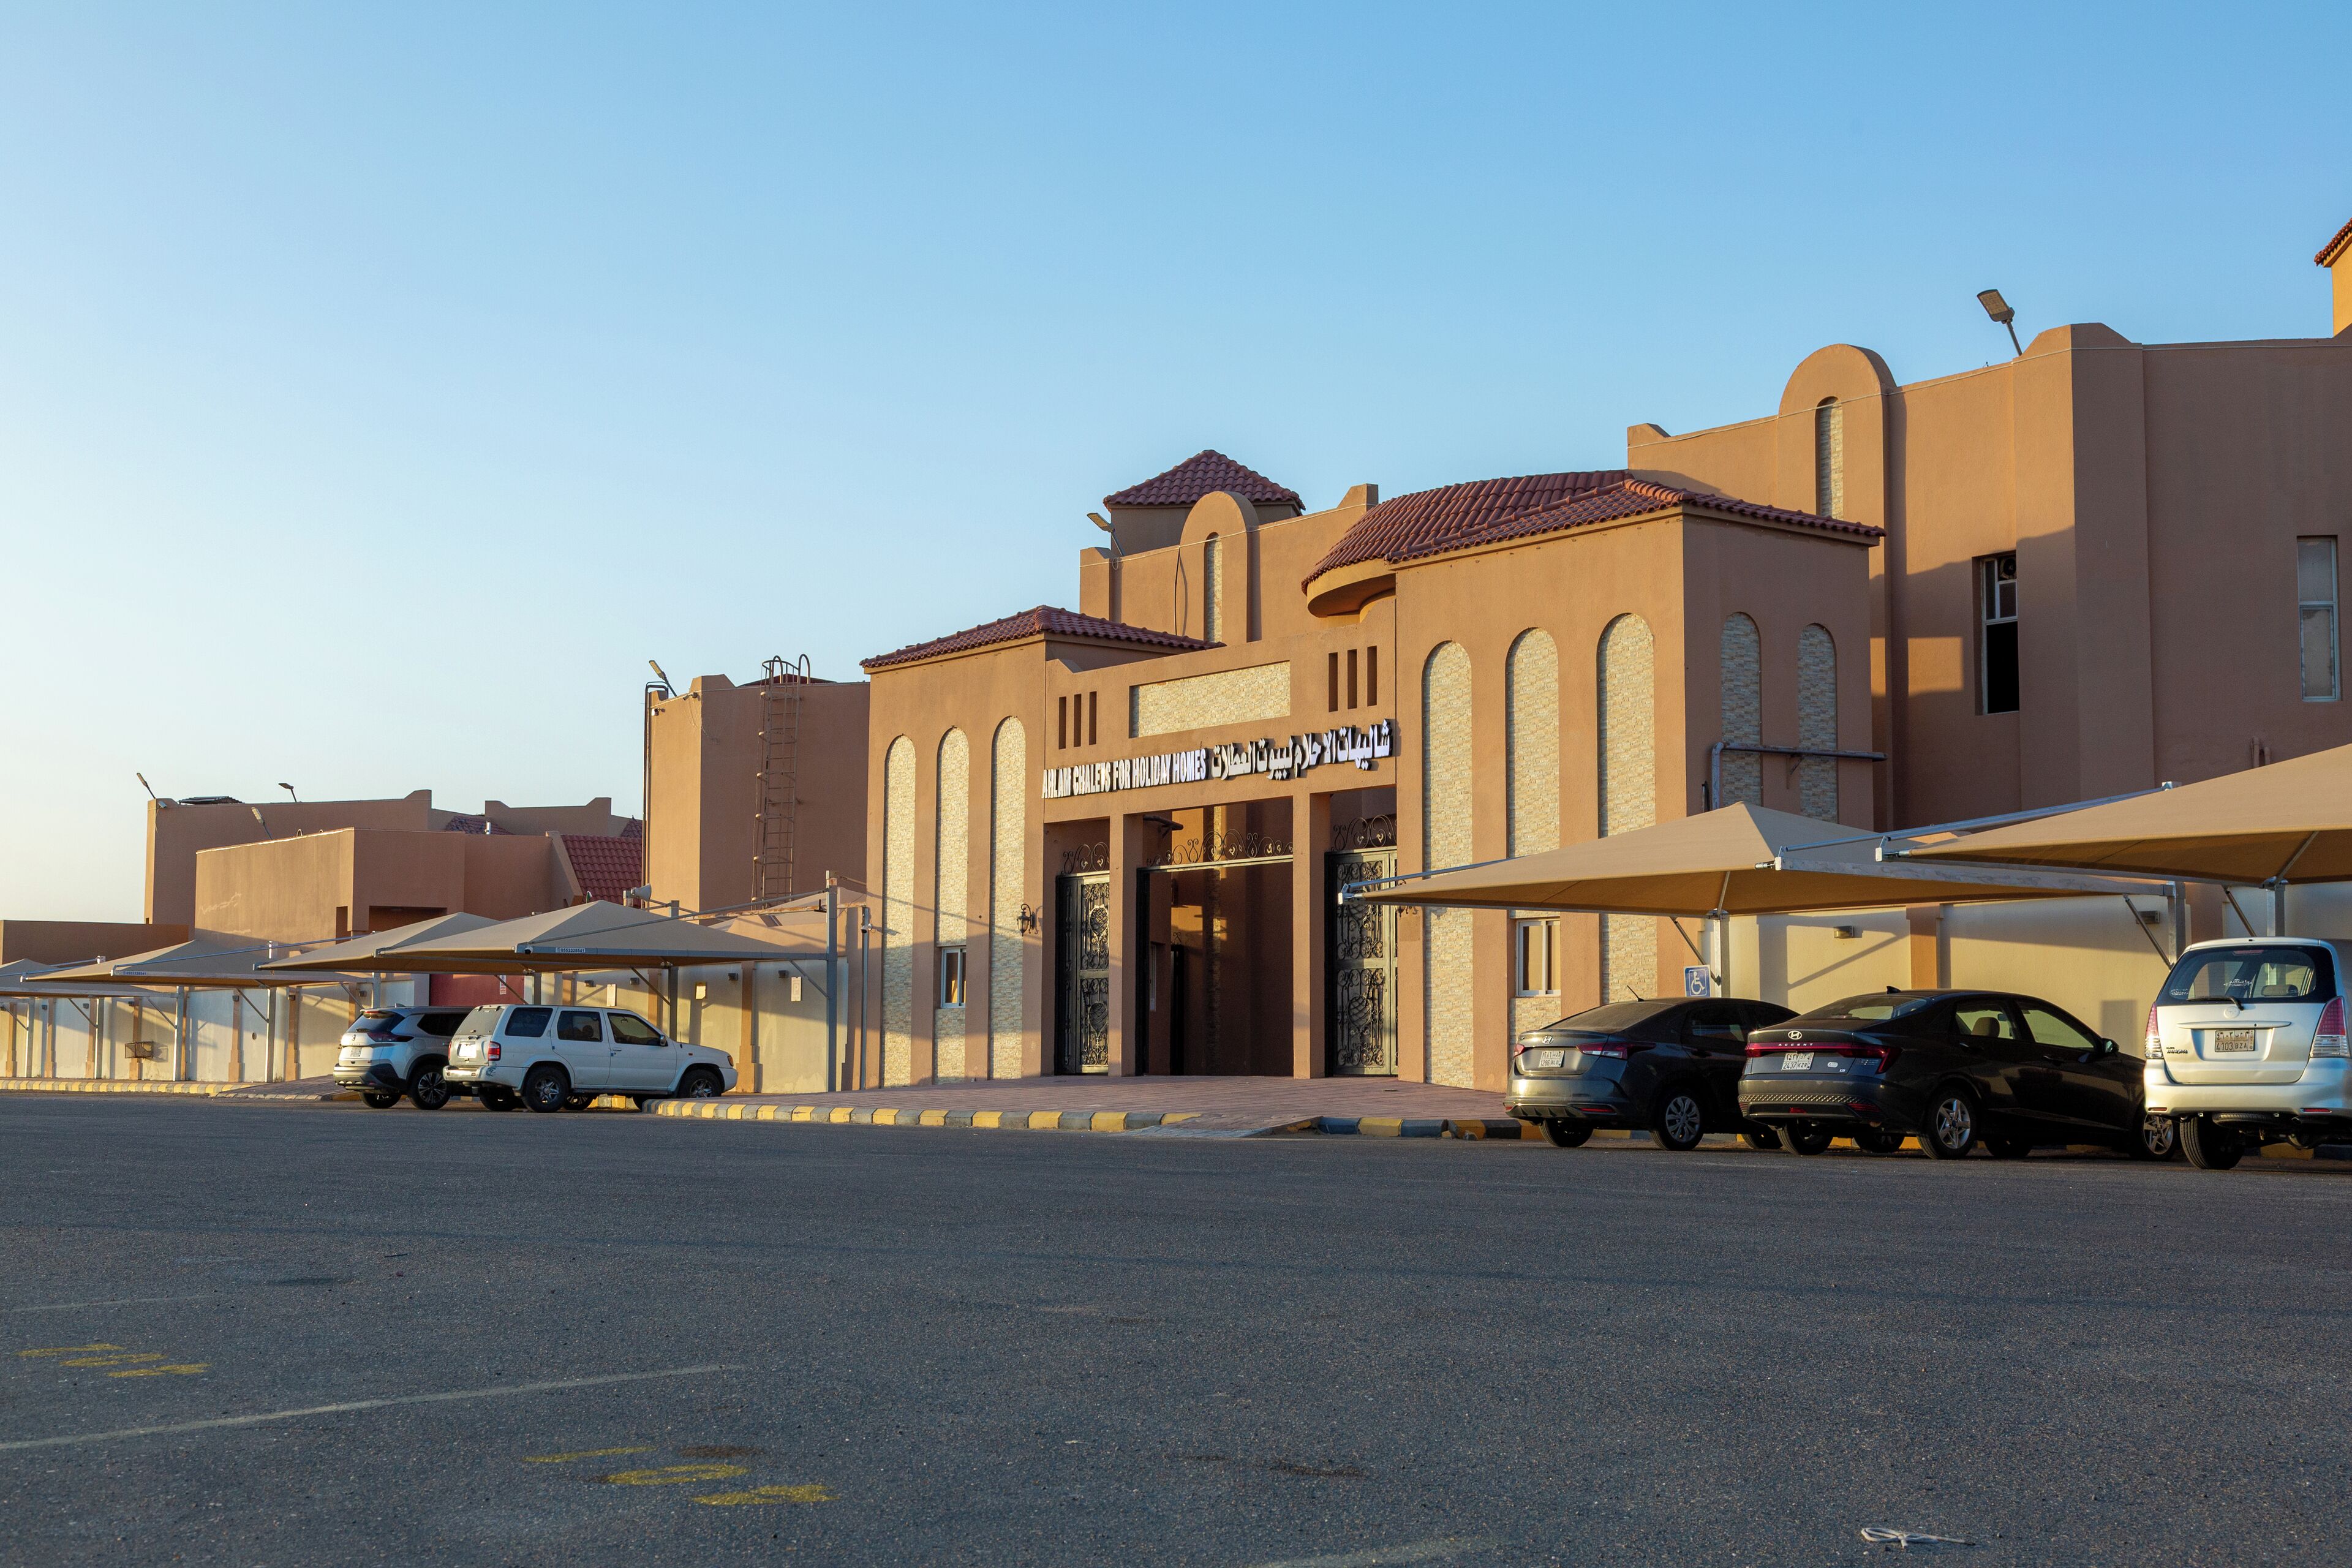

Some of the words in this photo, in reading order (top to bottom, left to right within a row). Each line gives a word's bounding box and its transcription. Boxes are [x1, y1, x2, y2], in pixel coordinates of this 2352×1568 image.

[1212, 741, 1256, 781] العطلات
[1257, 736, 1294, 780] لبيوت
[1338, 718, 1392, 771] شاليهات
[1041, 767, 1072, 799] AHLAM
[1073, 761, 1111, 796] CHALETS
[1113, 759, 1131, 791] FOR
[1132, 753, 1172, 788] HOLIDAY
[1172, 748, 1207, 783] HOMES
[2216, 1042, 2233, 1051] 4103
